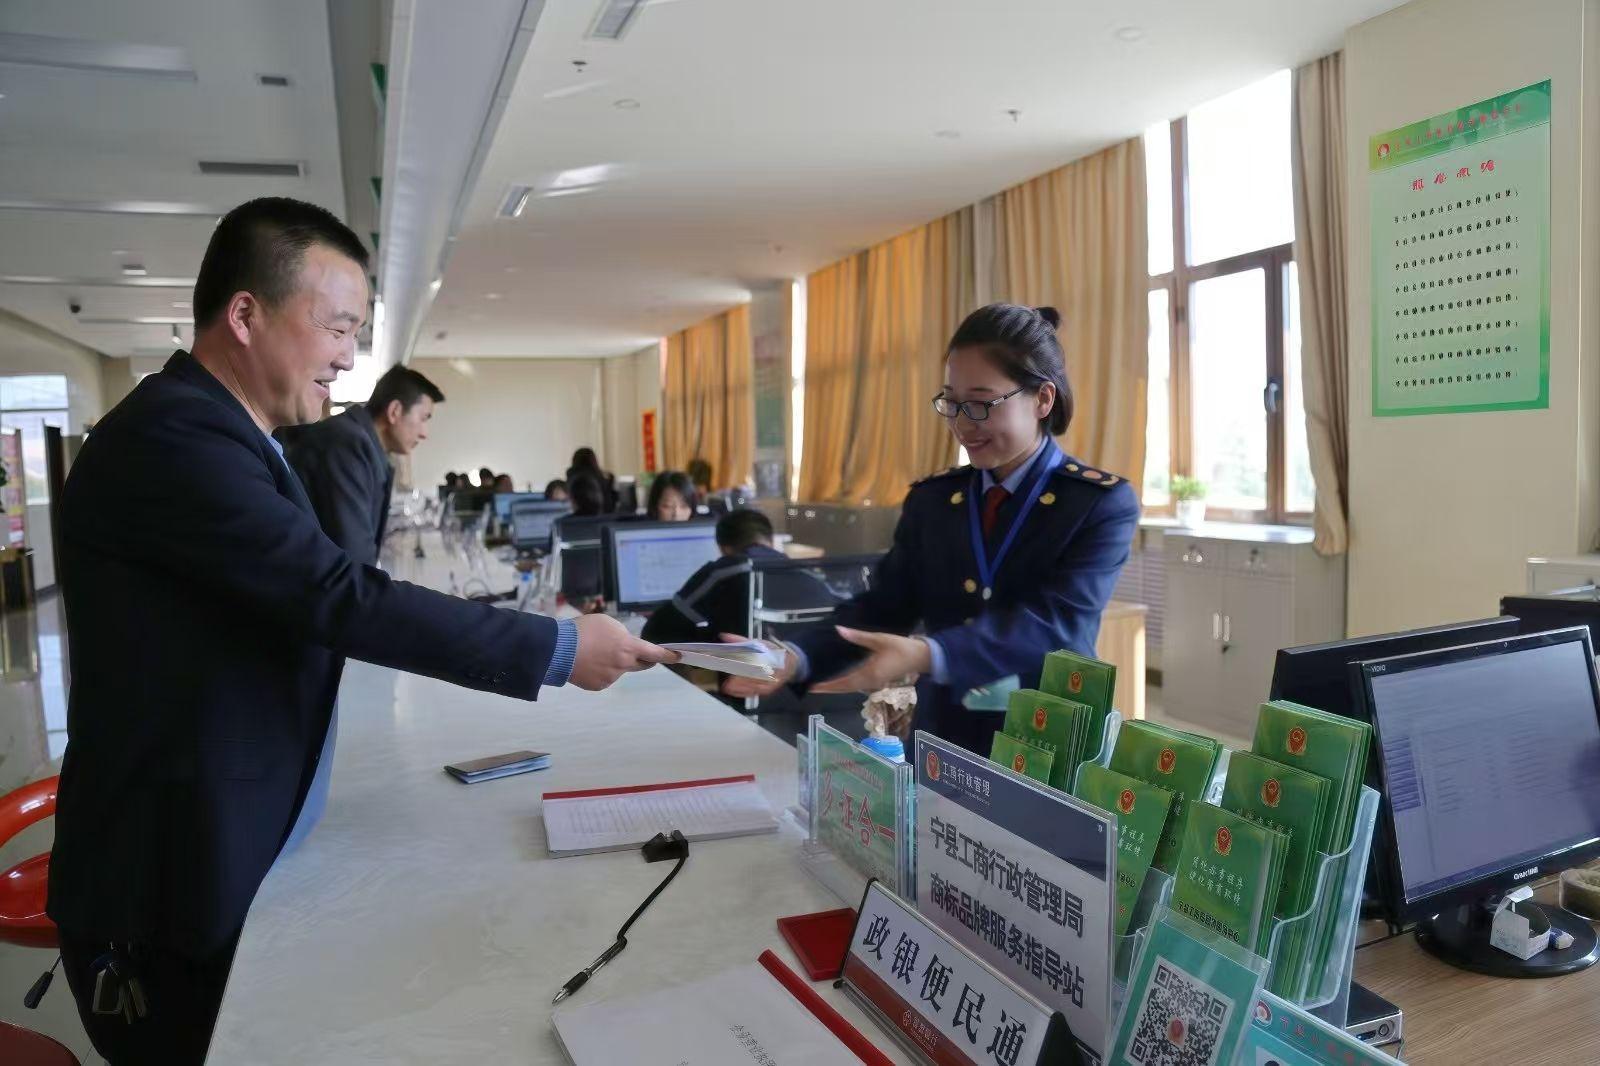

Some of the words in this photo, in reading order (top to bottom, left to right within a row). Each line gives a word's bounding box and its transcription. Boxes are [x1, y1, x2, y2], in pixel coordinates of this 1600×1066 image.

[930, 816, 1084, 939] 宁县工商行政管理局
[930, 873, 1085, 1009] 商标品牌服务指导站
[862, 912, 1027, 1066] 政银便民通
